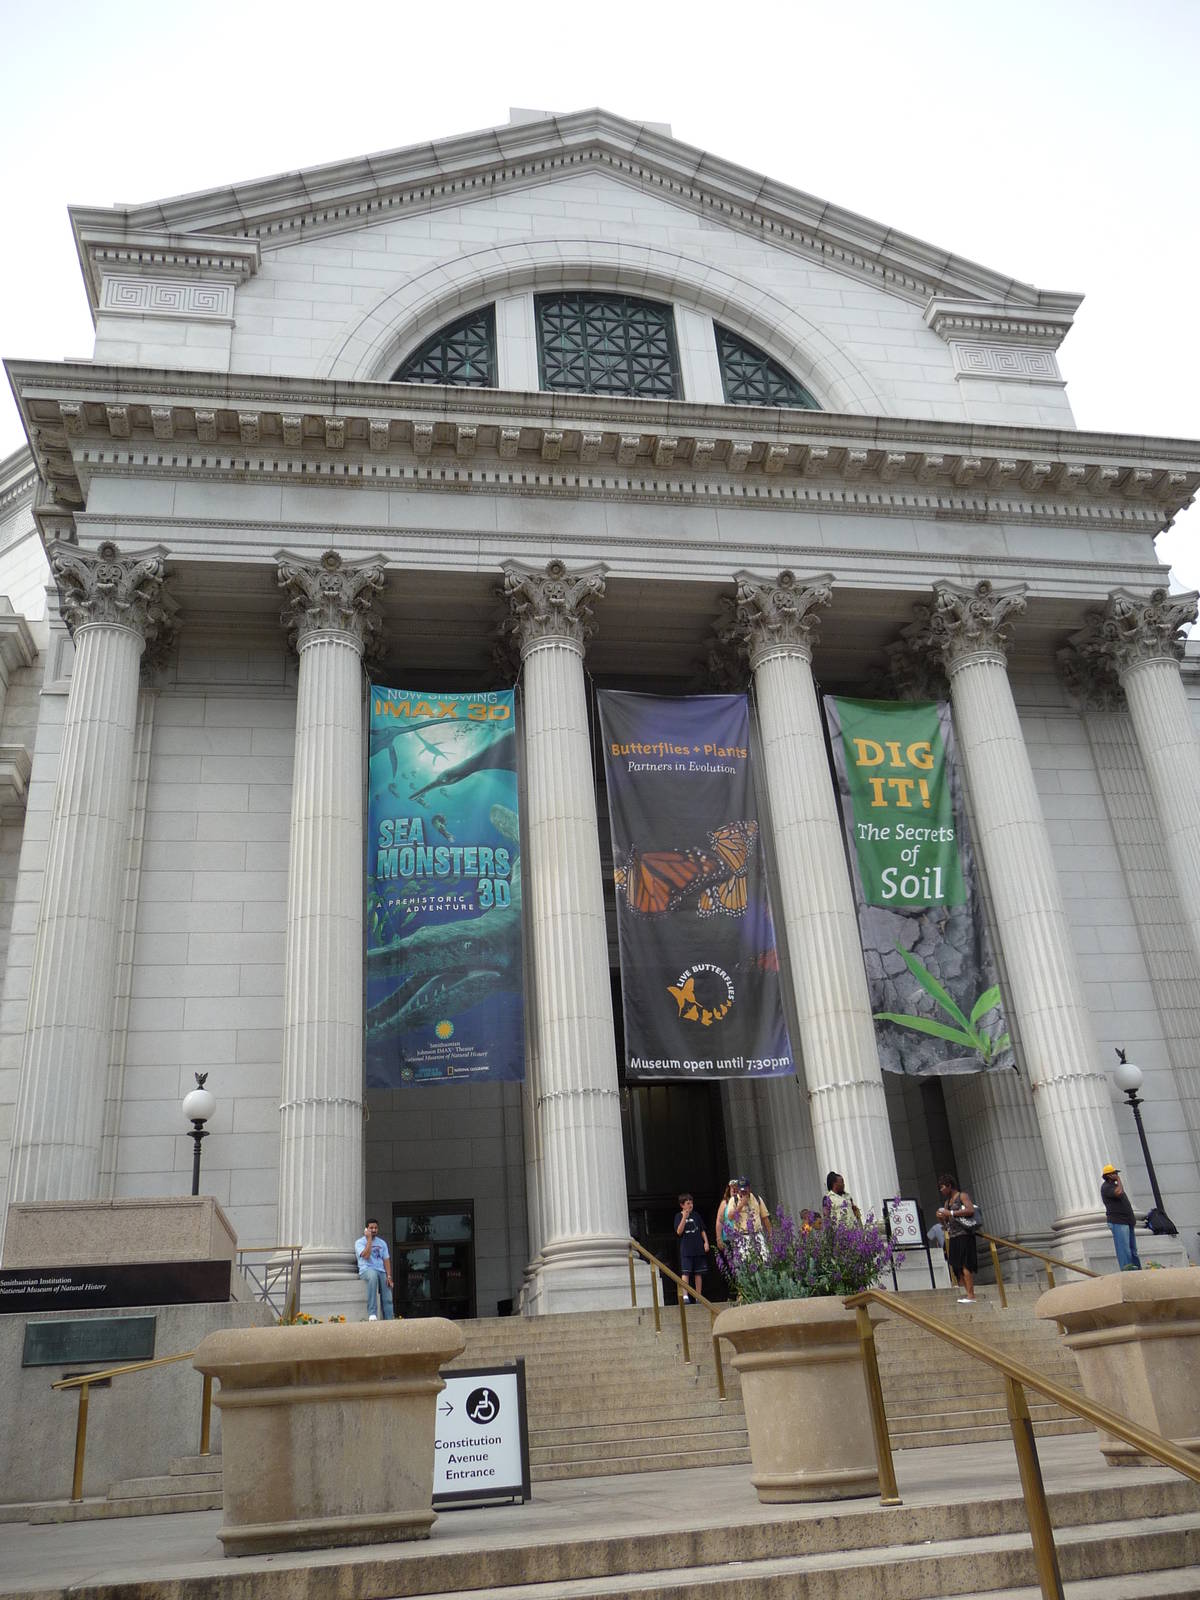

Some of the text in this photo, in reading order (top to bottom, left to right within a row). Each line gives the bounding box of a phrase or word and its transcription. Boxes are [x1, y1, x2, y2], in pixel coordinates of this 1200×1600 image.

[387, 690, 422, 700] NOW
[375, 699, 511, 721] IMAX 3D
[611, 742, 690, 758] Butterflies
[703, 743, 748, 759] Plants
[853, 738, 934, 770] DIG
[628, 761, 736, 775] Partners in Evolution
[869, 777, 932, 809] IT!
[378, 817, 425, 848] SEA
[857, 823, 954, 842] The Secrets
[376, 846, 512, 879] MONSTERS
[900, 844, 921, 867] of
[881, 866, 945, 899] Soil
[388, 896, 466, 907] PREHISTORIC
[477, 878, 512, 910] 3D
[406, 904, 475, 913] ADVENTURE
[676, 963, 736, 1000] LIVE BUTTERFLIES
[630, 1056, 790, 1072] Museum open until 7:30pm
[0, 1277, 72, 1287] Smithsonian Institution
[0, 1282, 107, 1295] National Museum of Natural History
[434, 1435, 502, 1450] Constitution
[448, 1453, 489, 1464] Avenue
[446, 1467, 496, 1480] Entrance
